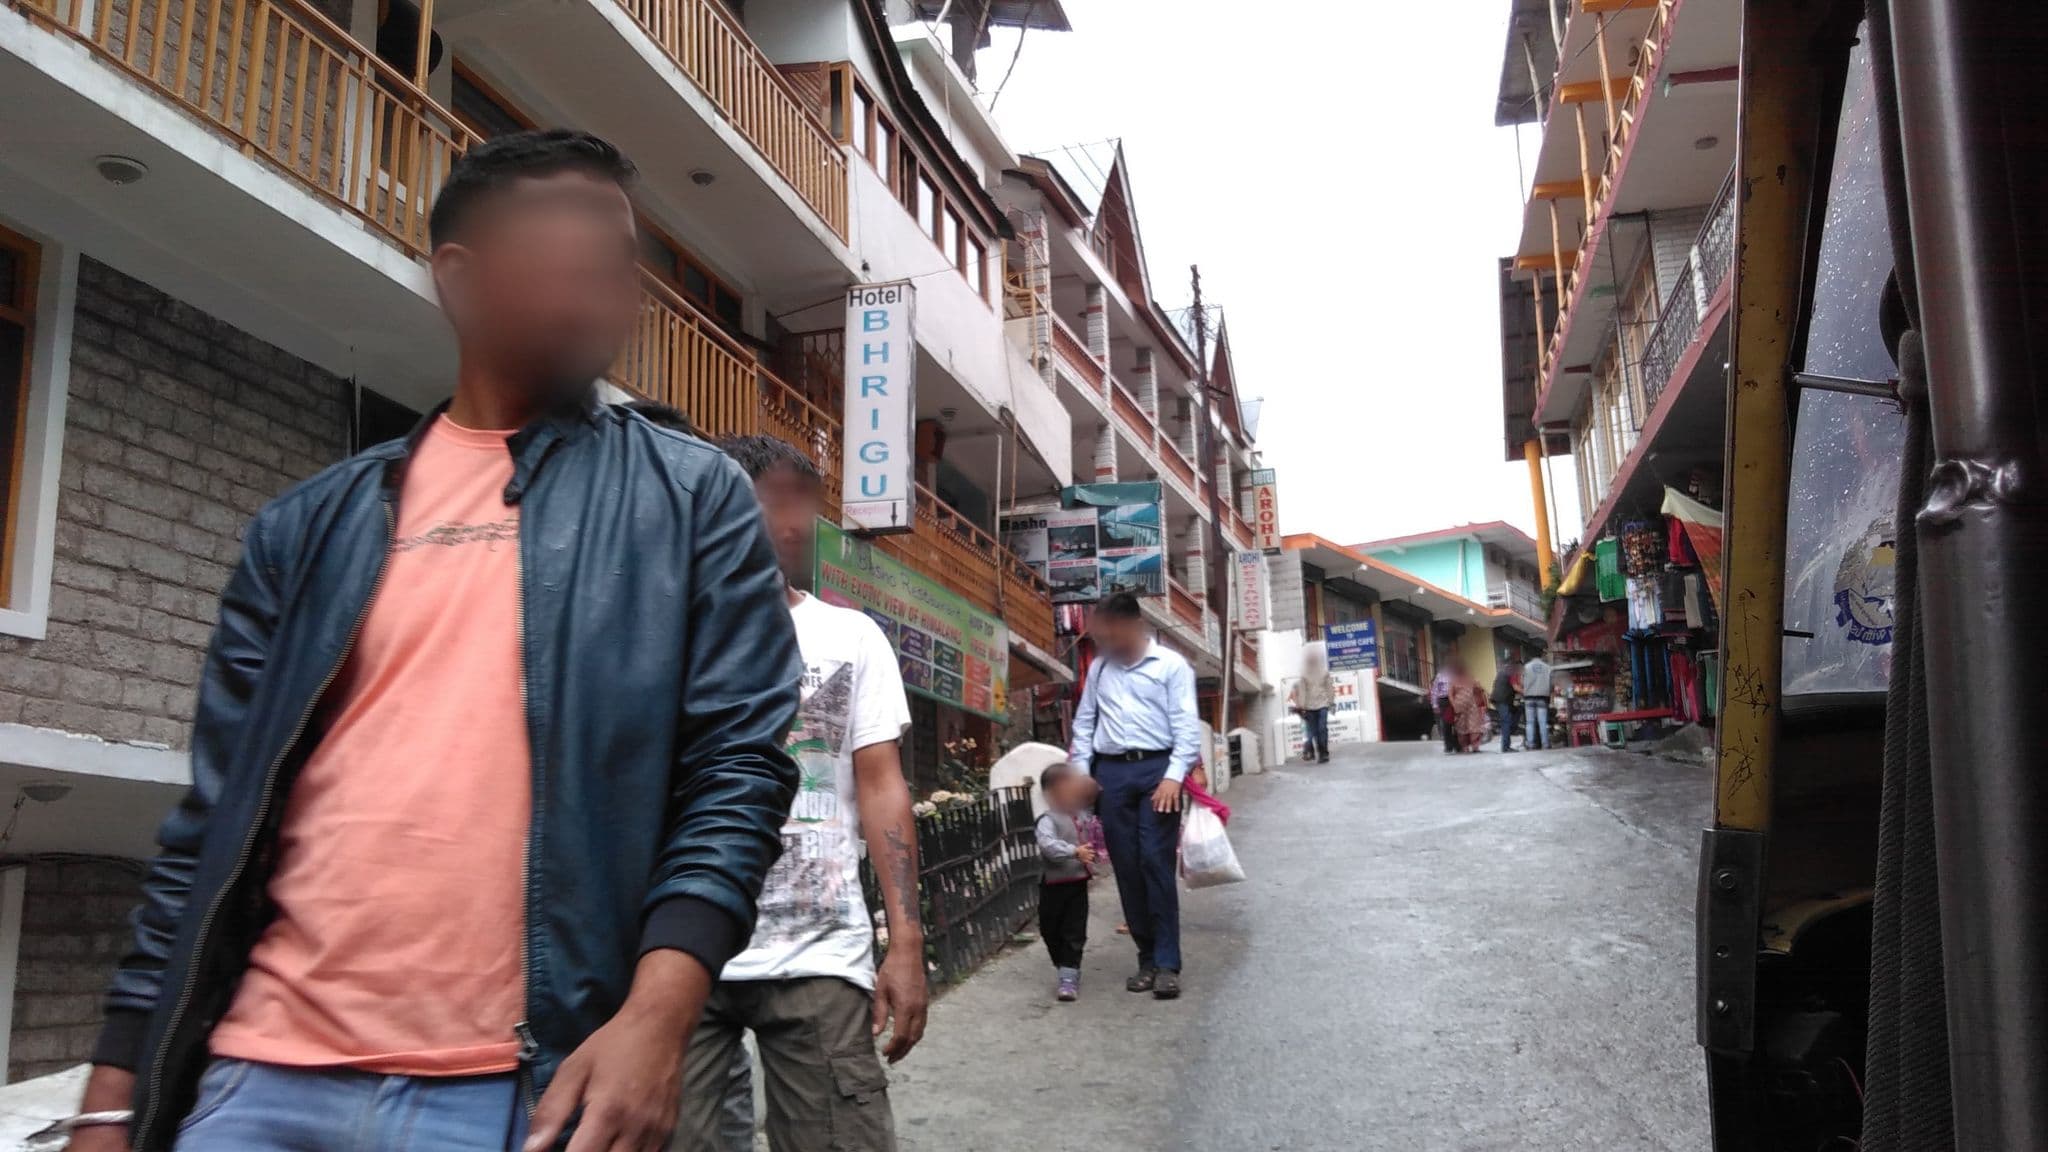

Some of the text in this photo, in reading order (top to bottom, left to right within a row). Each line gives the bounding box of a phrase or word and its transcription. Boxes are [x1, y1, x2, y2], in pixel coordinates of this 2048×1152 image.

[849, 288, 903, 308] Hotel
[859, 309, 890, 498] BHRIGU
[1000, 518, 1048, 531] Basho
[1259, 486, 1275, 547] AROHI
[822, 561, 848, 589] WITH
[851, 576, 881, 607] EXOTIC
[884, 592, 906, 617] VIEW
[908, 605, 919, 623] OF
[1331, 622, 1369, 635] WELCOME
[1358, 637, 1374, 646] CAFE
